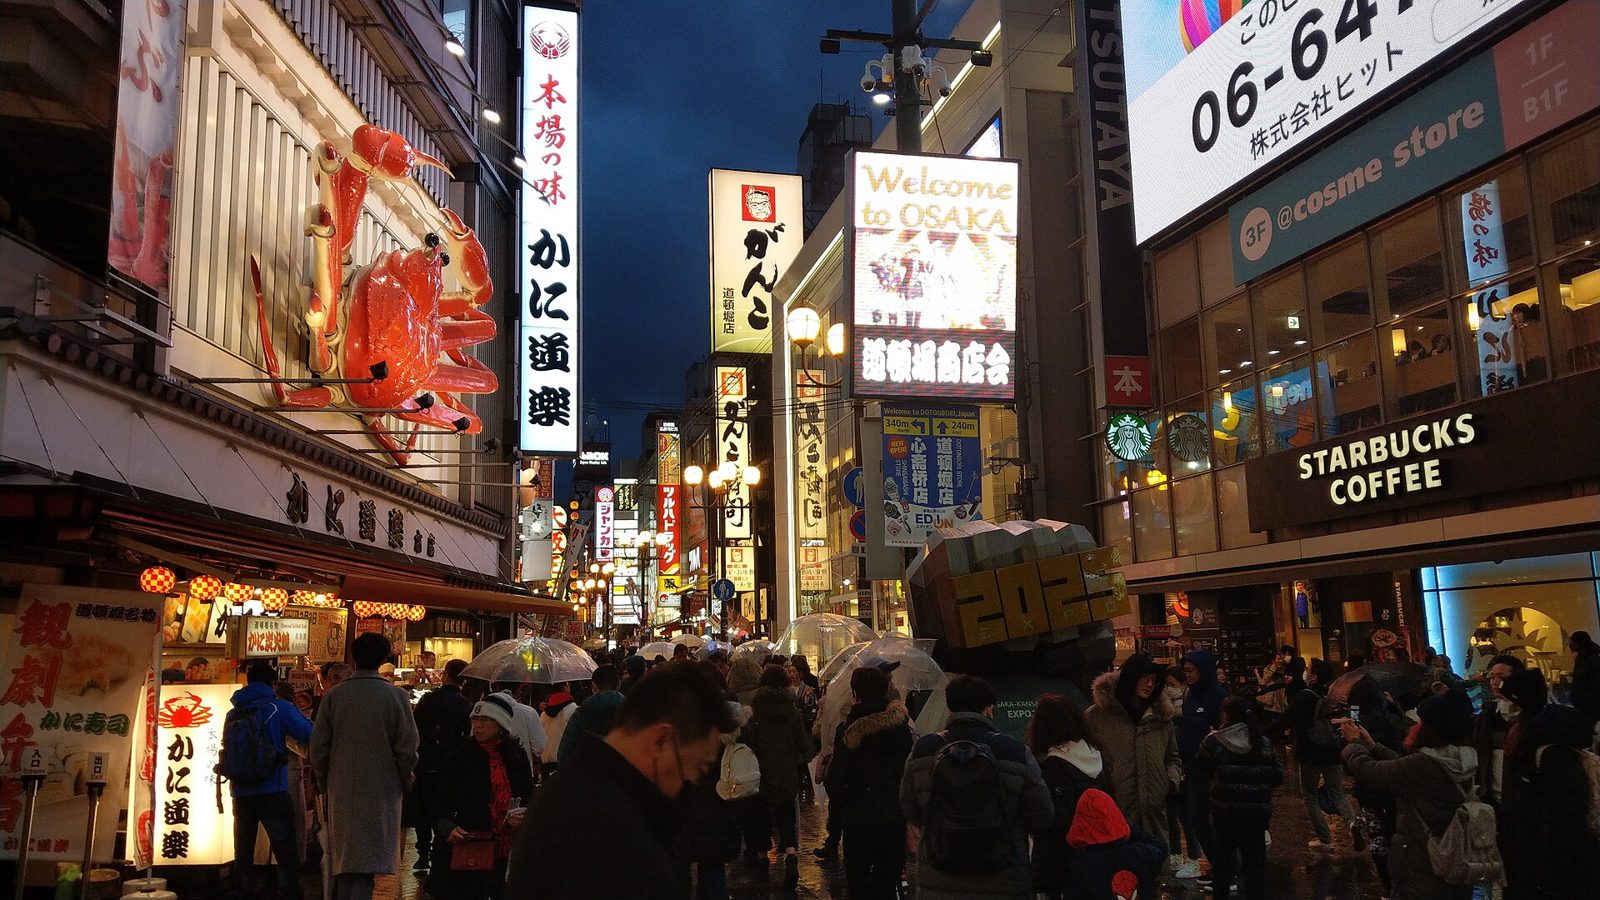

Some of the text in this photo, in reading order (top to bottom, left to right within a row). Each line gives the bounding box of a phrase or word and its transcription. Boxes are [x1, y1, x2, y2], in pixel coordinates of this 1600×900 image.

[1526, 32, 1554, 66] 1F
[1192, 0, 1413, 152] 06-64
[1089, 2, 1132, 211] TSUTAYA
[1251, 41, 1403, 161] 株式会社ヒット
[1523, 79, 1569, 122] B1F
[532, 74, 567, 206] 本場の味
[861, 164, 1013, 200] Welcome
[1246, 100, 1485, 248] 3F @cosme store
[861, 202, 1014, 233] to OSAKA
[741, 222, 786, 330] がんこ
[527, 228, 571, 427] かに道楽
[722, 288, 735, 334] 道頓堀店
[1112, 366, 1143, 396] 本
[886, 418, 909, 427] 340m
[952, 421, 975, 430] 240m
[1299, 413, 1475, 480] STARBUCKS
[1330, 459, 1442, 505] COFFEE
[915, 514, 954, 528] EDION
[950, 546, 1132, 649] 2025
[1394, 582, 1404, 626] STARBUCK
[39, 711, 131, 738] かに寿司
[997, 700, 1039, 708] SAKA-KANS
[1008, 710, 1036, 718] EXPO
[31, 750, 41, 768] 入口
[94, 756, 103, 773] 出口
[162, 734, 194, 860] かに道楽
